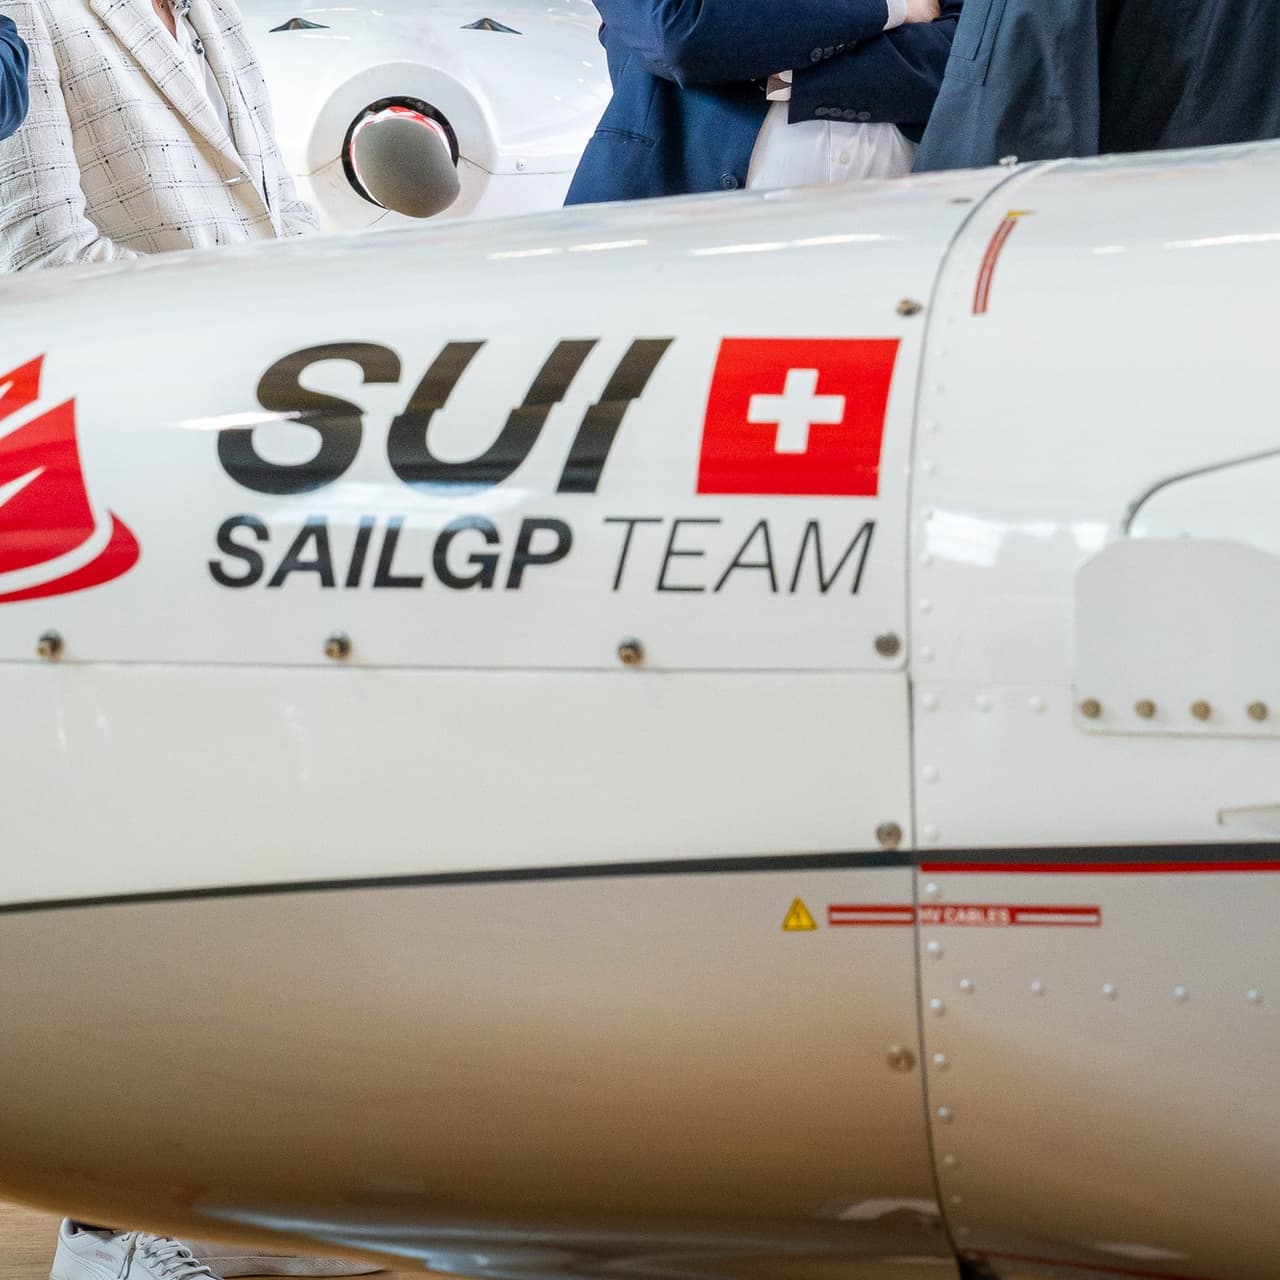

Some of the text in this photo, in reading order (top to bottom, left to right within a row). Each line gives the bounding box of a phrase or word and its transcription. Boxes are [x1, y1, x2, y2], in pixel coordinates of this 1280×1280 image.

[217, 337, 675, 497] SUI
[207, 515, 878, 595] SAILGP TEAM
[943, 906, 1010, 926] CABLES
